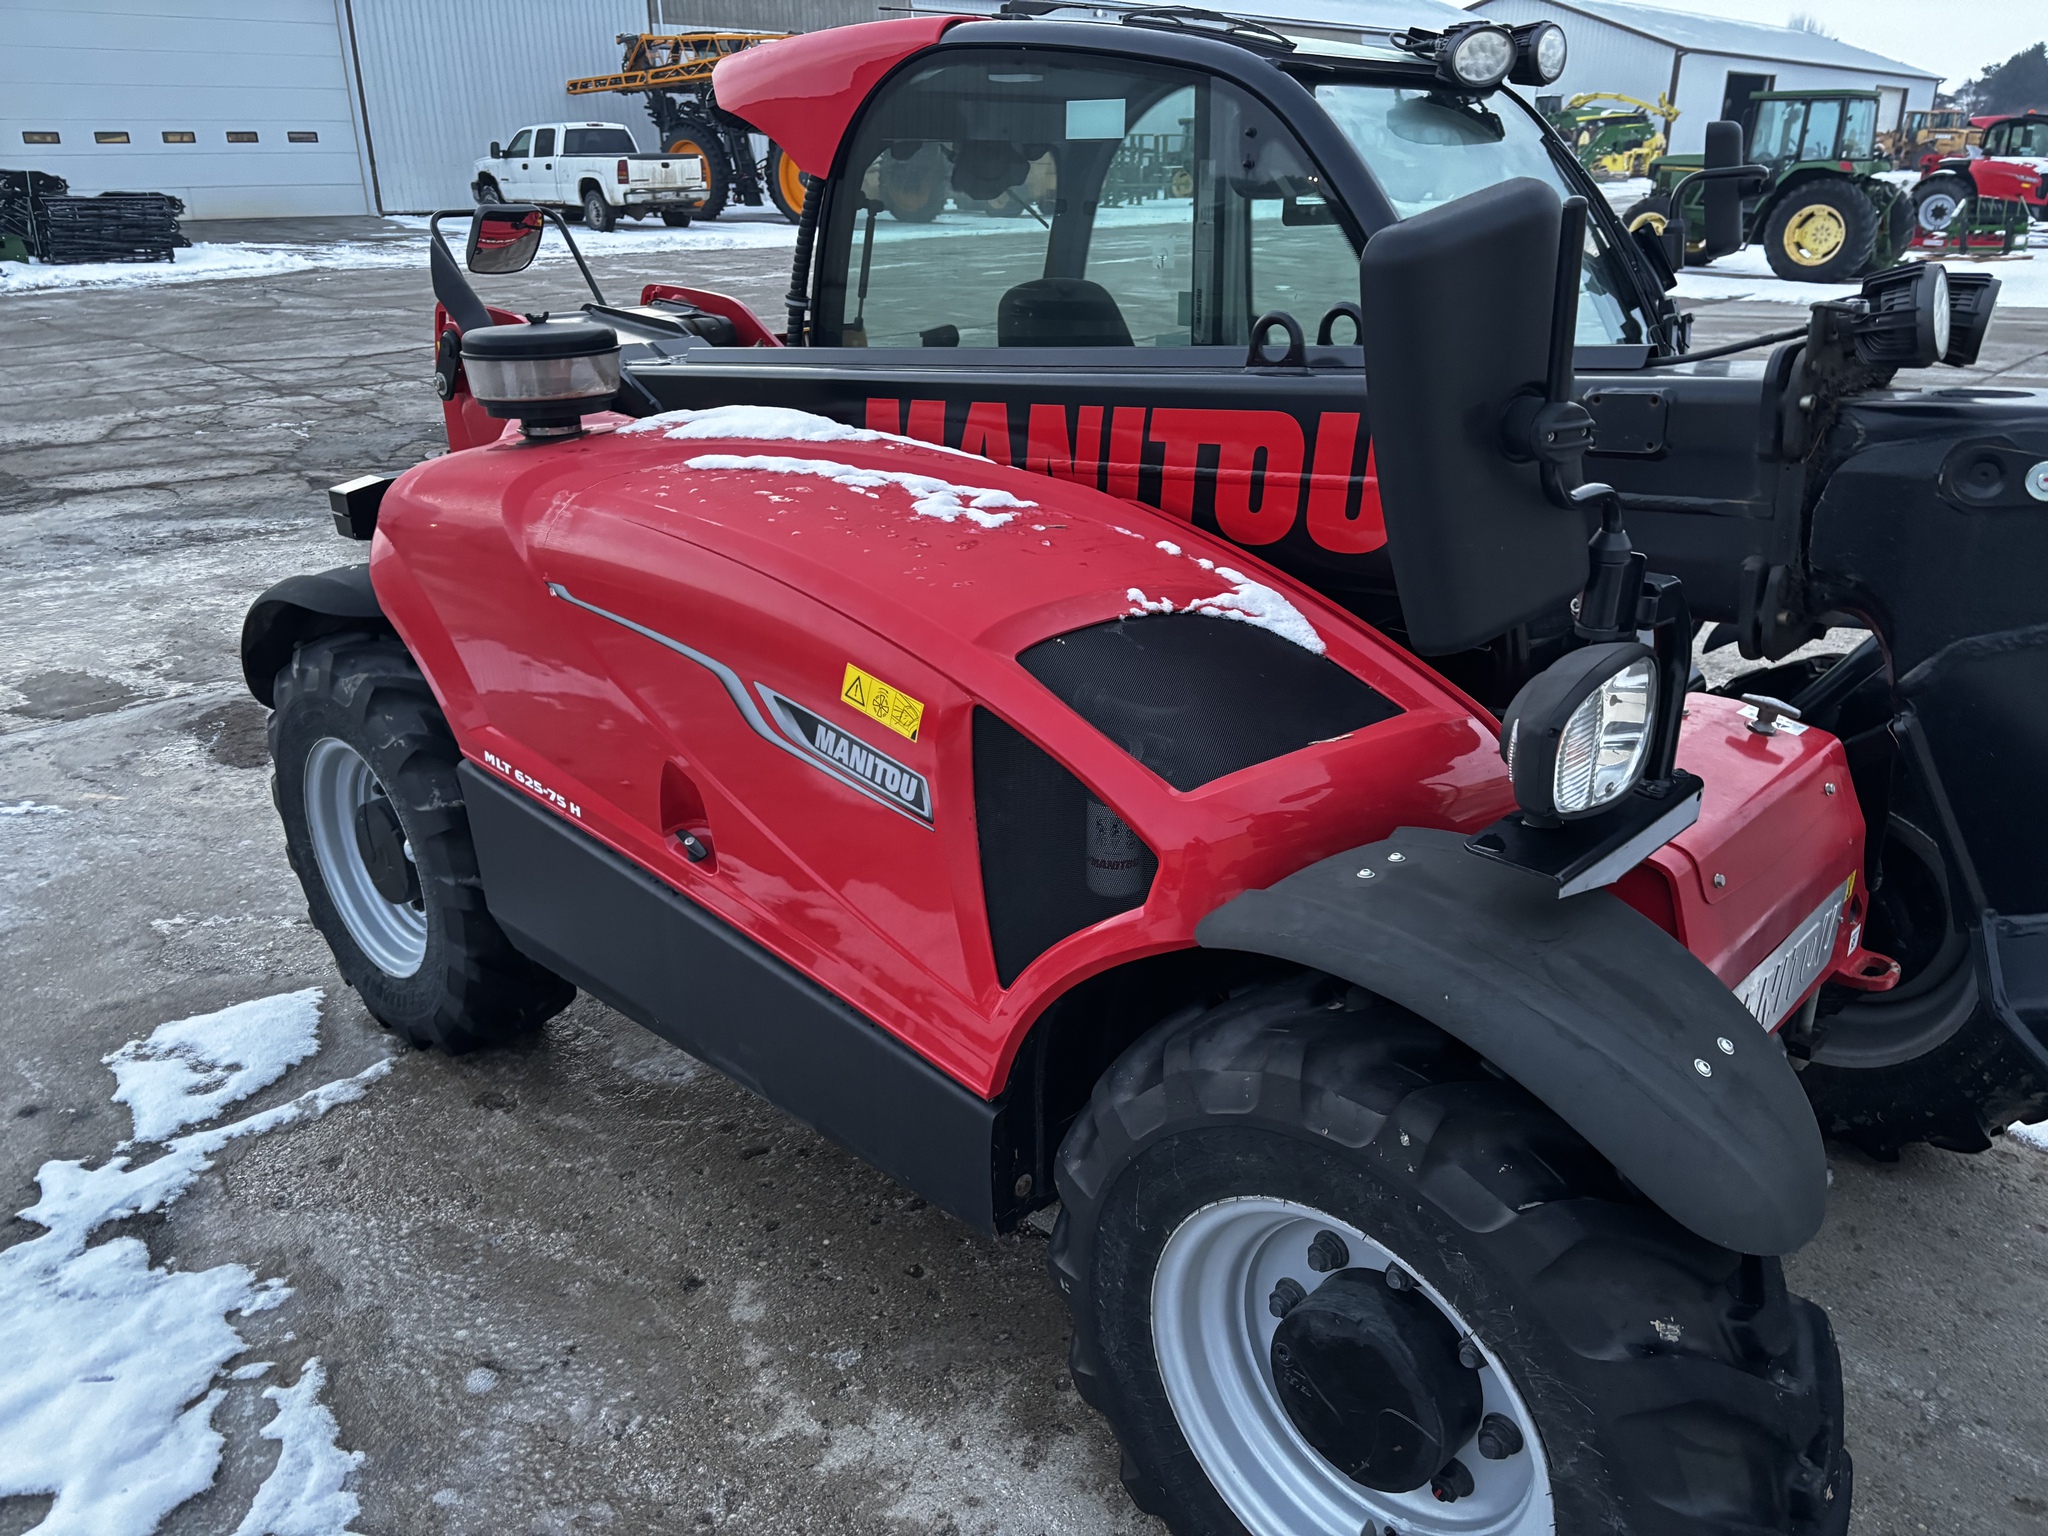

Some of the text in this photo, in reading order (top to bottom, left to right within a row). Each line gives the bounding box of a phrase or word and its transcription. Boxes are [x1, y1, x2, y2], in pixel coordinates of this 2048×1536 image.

[484, 750, 581, 818] MLT 625-75 H
[814, 723, 918, 802] MANITOU
